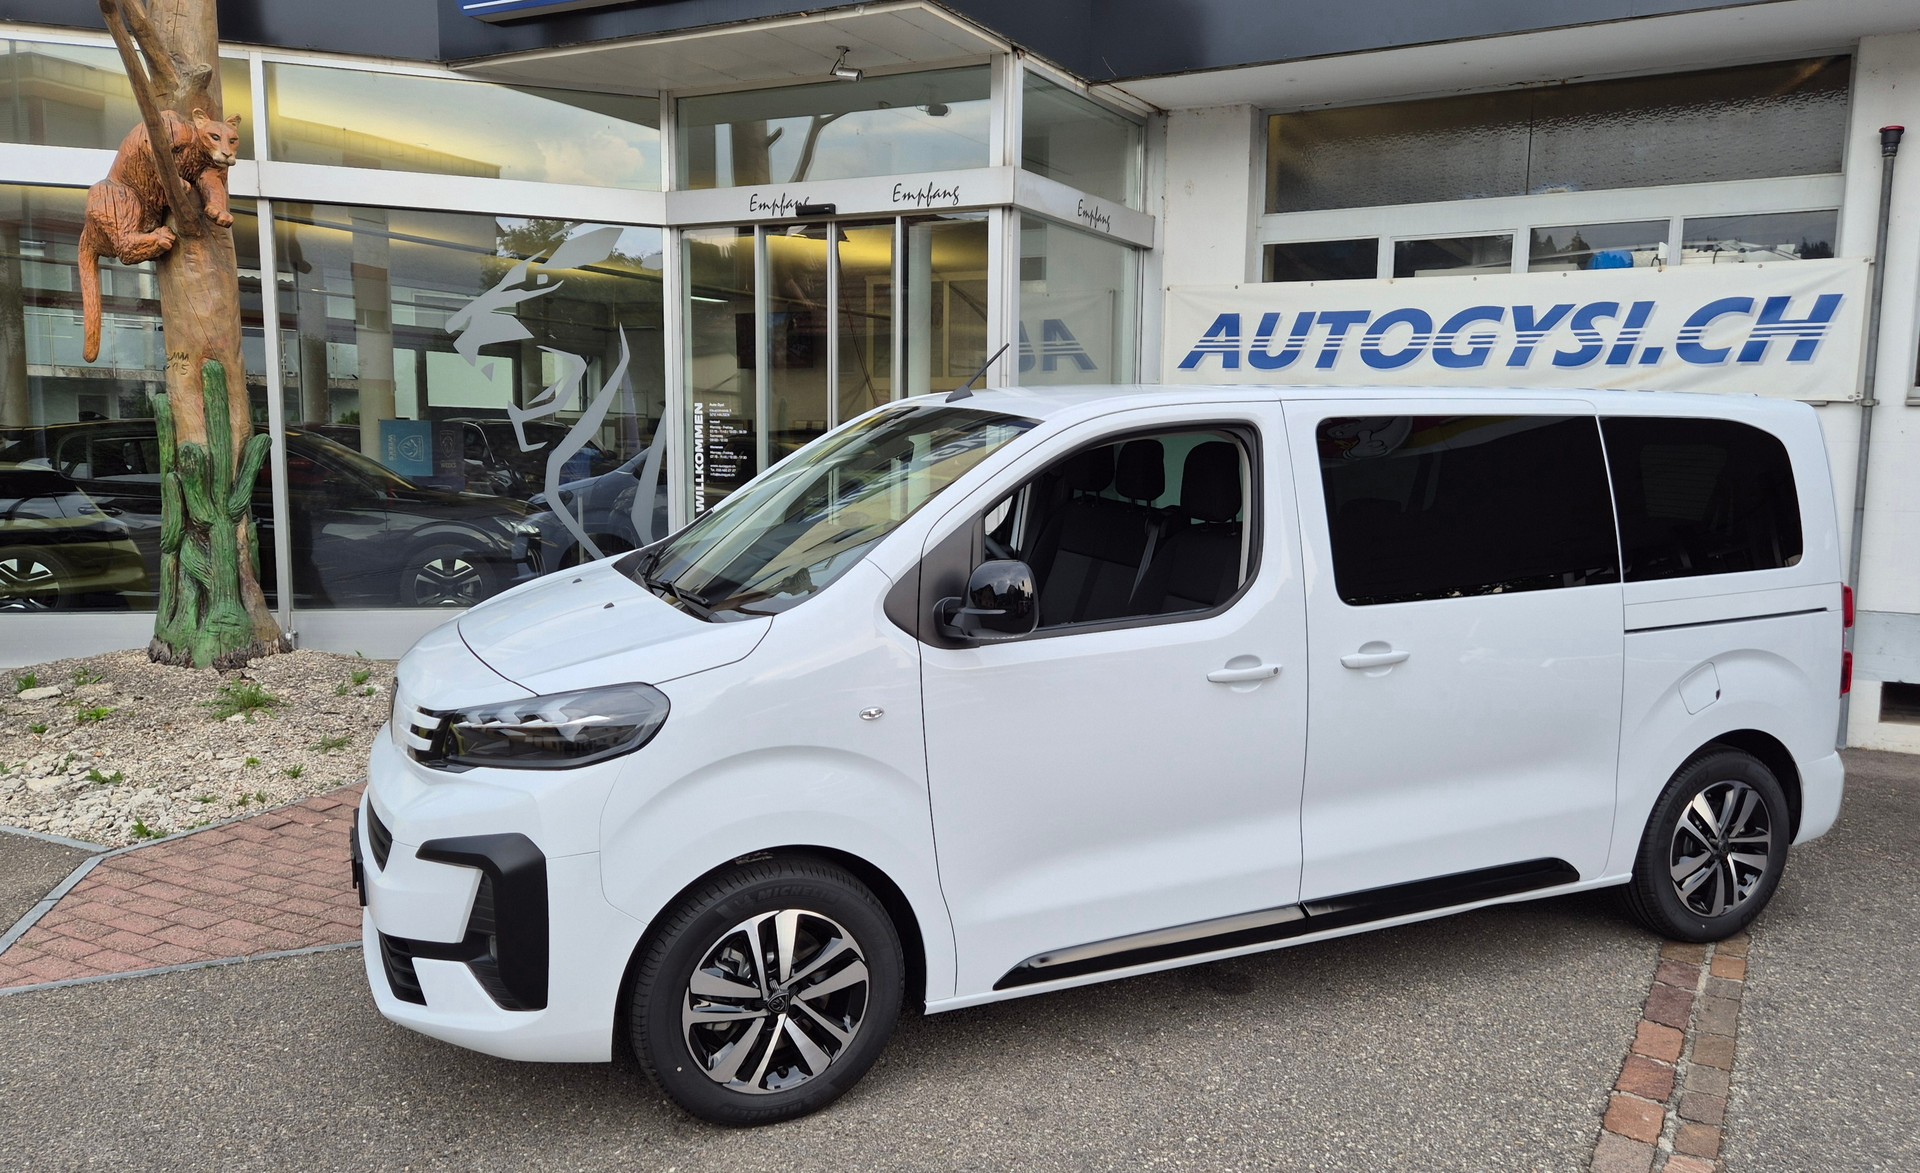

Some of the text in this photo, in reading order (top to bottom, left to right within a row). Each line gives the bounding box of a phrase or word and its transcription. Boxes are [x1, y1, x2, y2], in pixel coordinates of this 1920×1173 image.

[749, 192, 810, 216] Empfan
[892, 181, 960, 207] Empfang
[1077, 198, 1111, 233] Empfang
[1178, 293, 1845, 372] AUTOGYSI.CH
[694, 402, 705, 512] WILLKOMMEN
